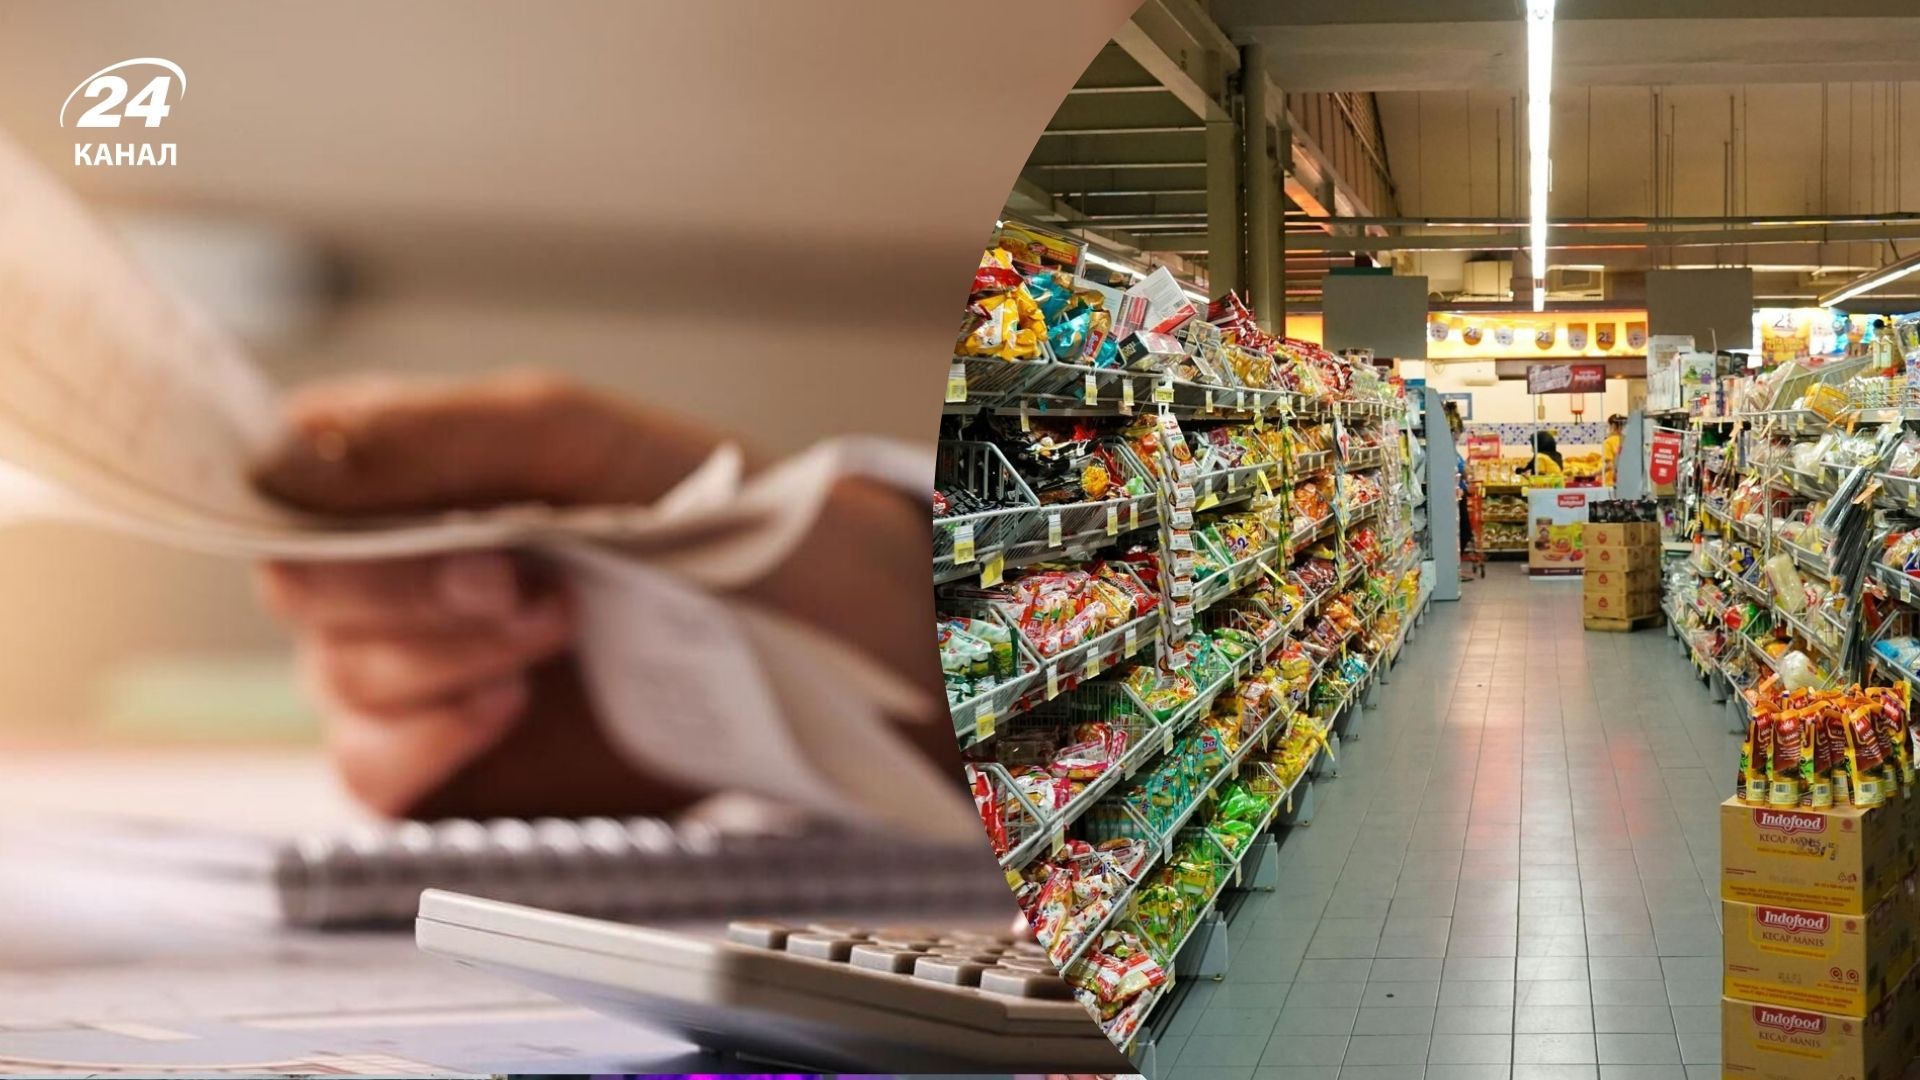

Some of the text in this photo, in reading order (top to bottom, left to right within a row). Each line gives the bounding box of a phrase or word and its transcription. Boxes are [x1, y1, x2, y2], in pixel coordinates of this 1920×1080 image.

[1761, 812, 1821, 830] Indofood
[1759, 833, 1787, 845] KECAP
[1764, 910, 1824, 929] Indofood
[1762, 931, 1824, 947] KECAP MANIS
[1761, 1010, 1821, 1030] Indofood
[1759, 1031, 1821, 1048] KECAP MANIS
